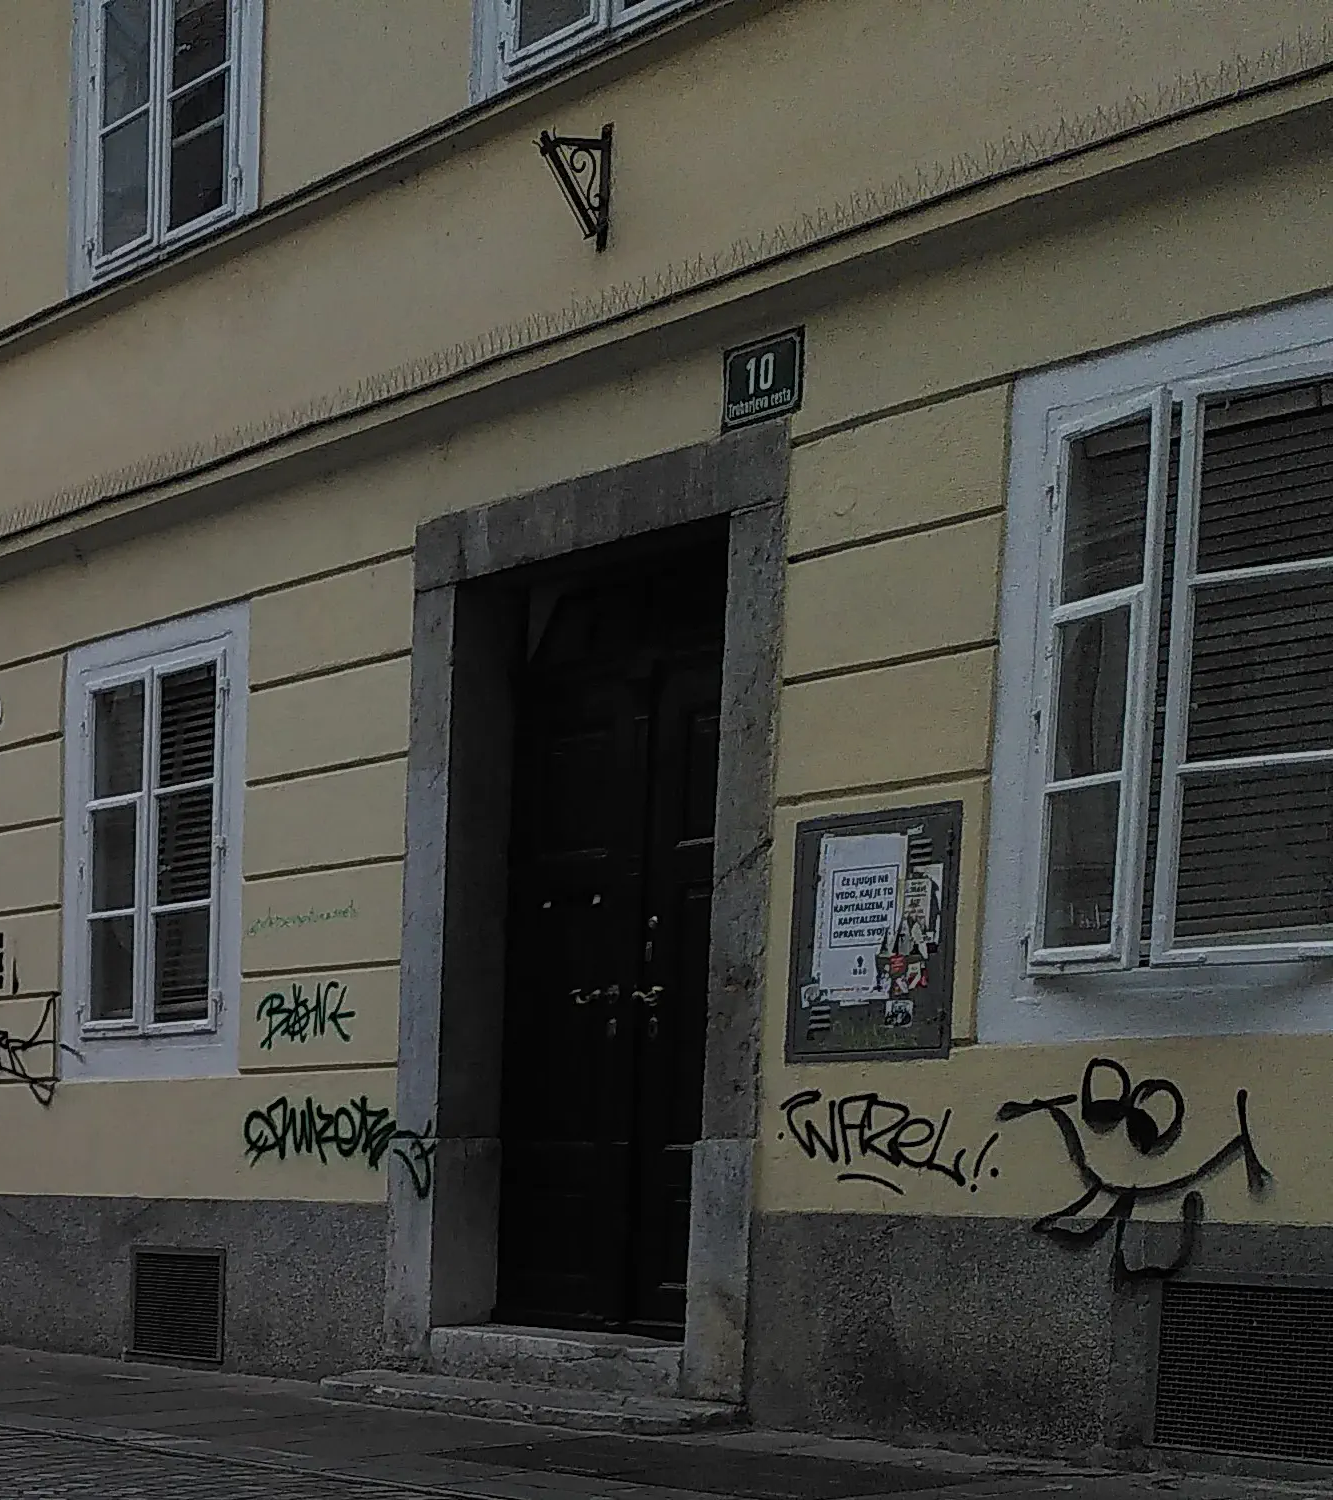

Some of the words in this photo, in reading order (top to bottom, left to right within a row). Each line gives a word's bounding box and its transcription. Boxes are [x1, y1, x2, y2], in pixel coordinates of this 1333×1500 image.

[745, 352, 775, 395] 10
[771, 387, 792, 407] cesta
[878, 873, 890, 884] NE
[883, 886, 894, 896] TO
